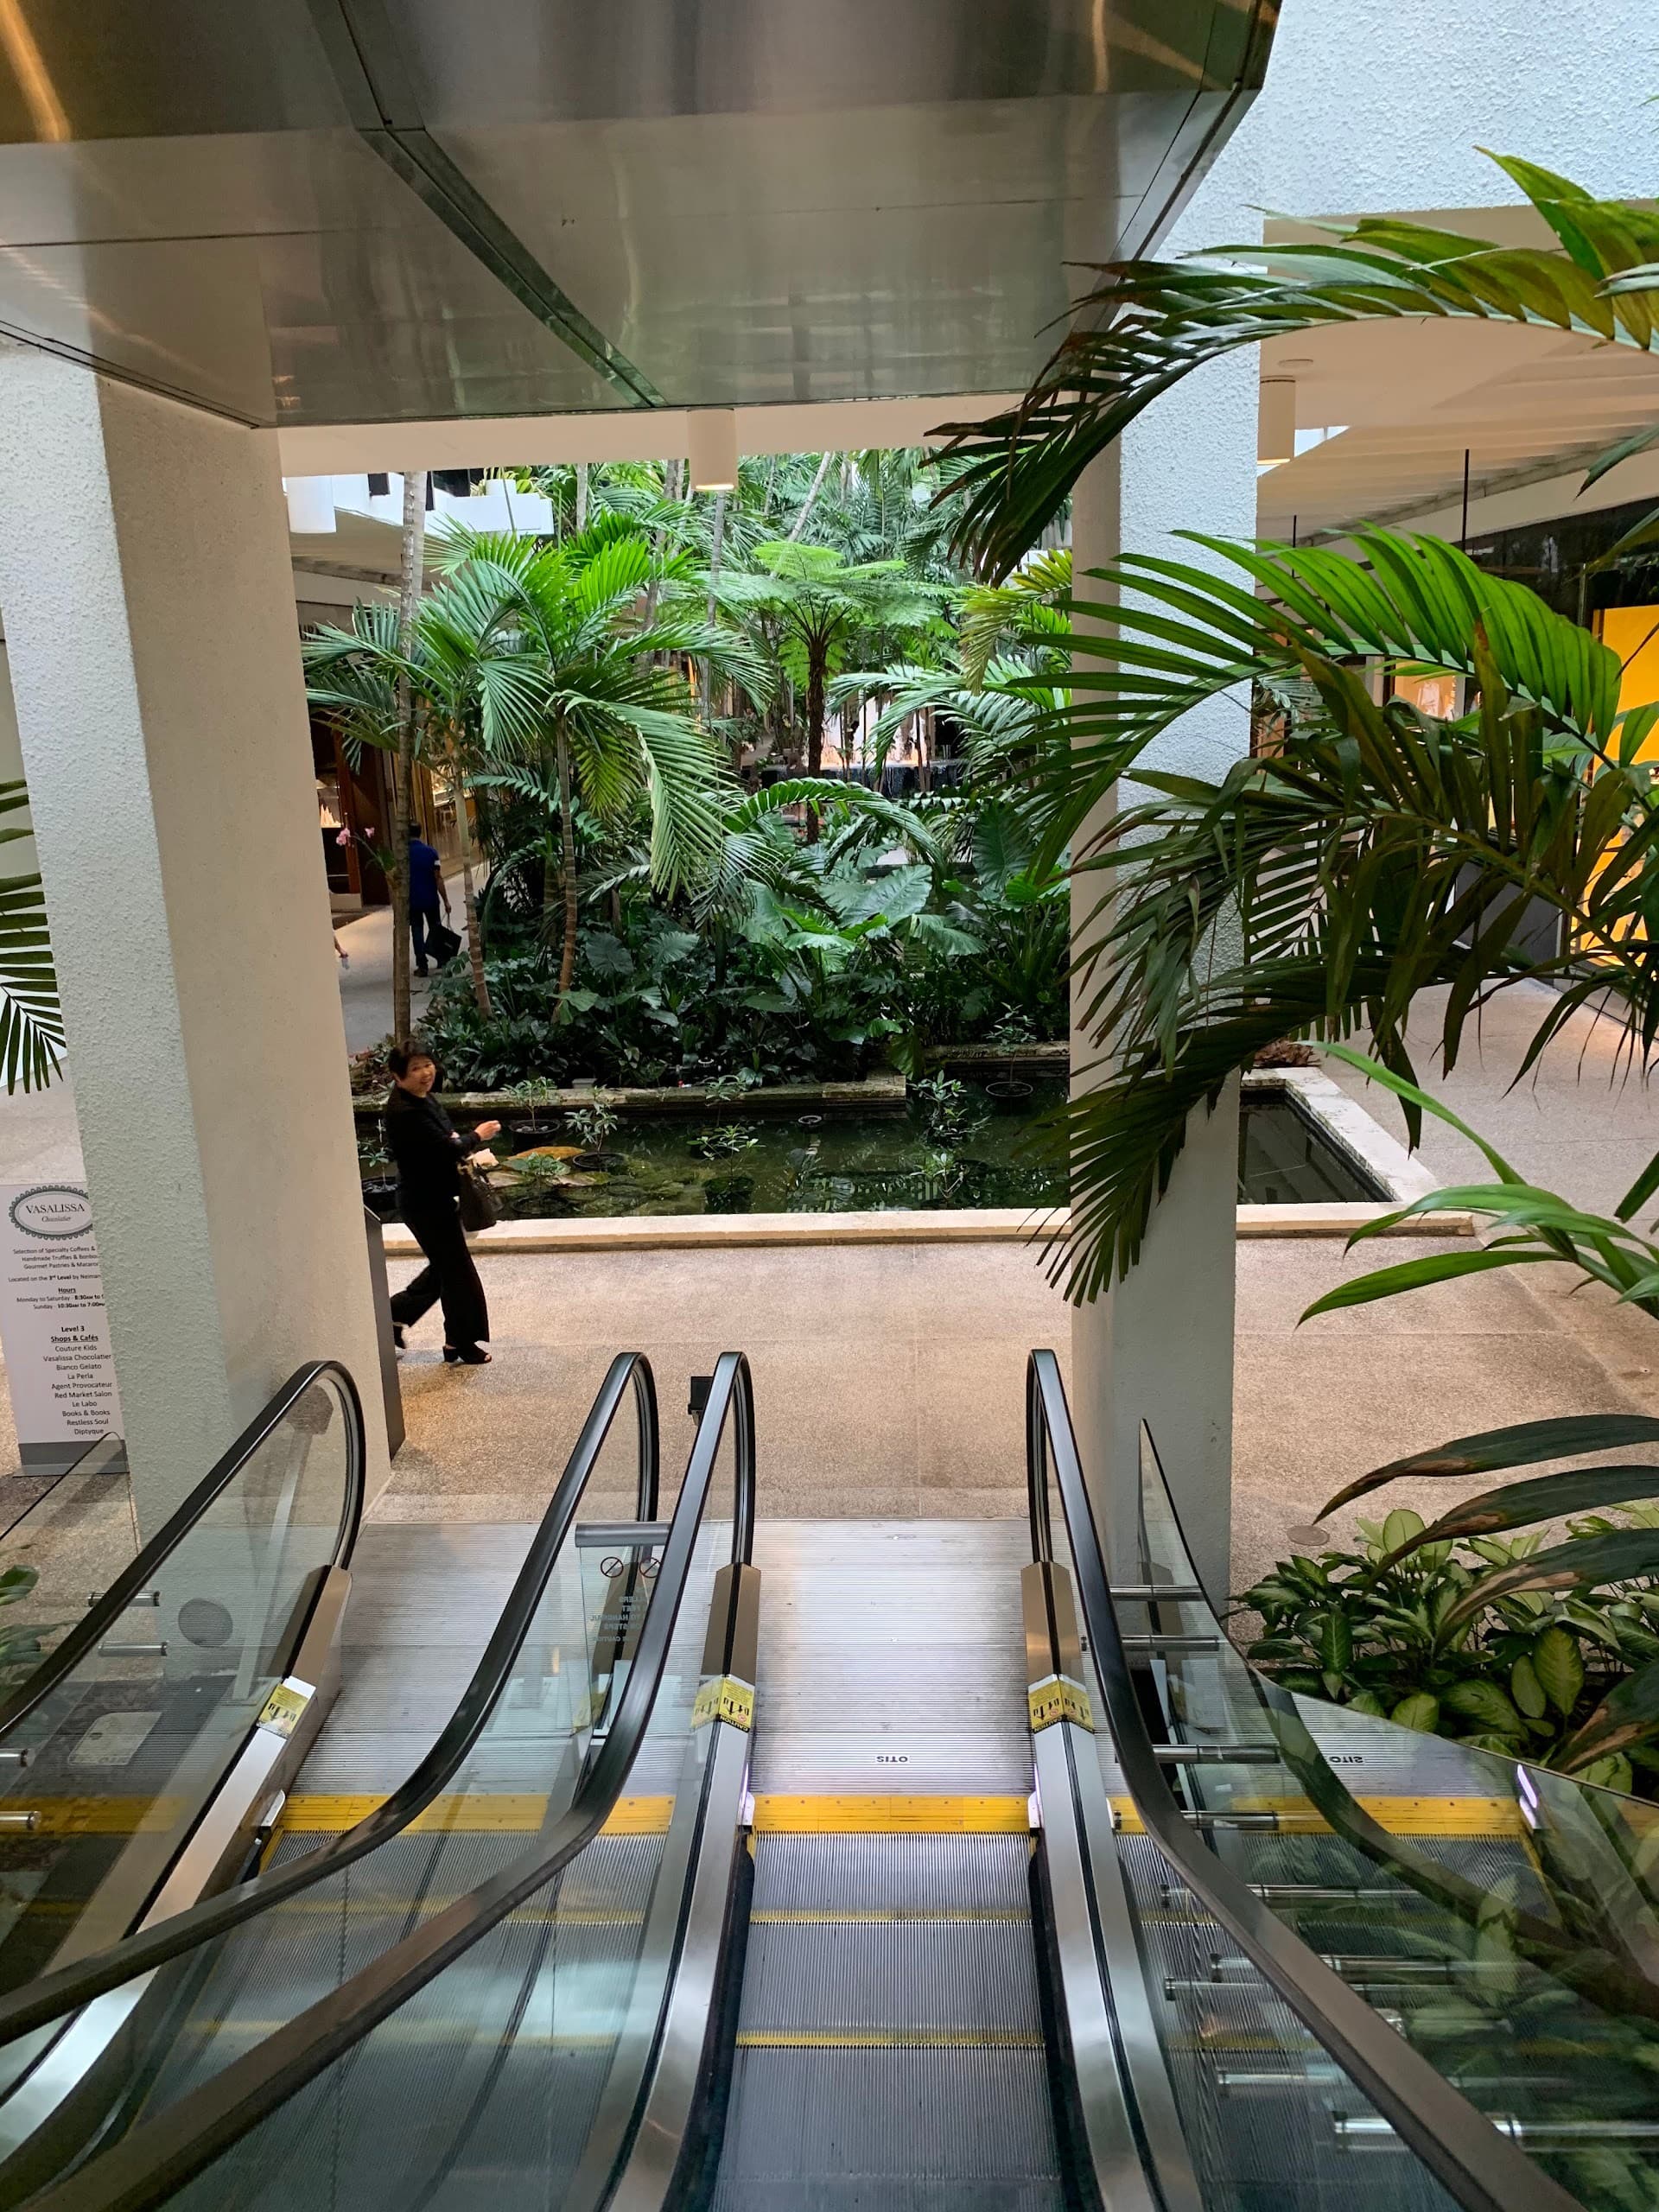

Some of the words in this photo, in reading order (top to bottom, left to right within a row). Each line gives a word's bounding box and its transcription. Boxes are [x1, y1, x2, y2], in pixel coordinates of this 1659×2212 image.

[26, 1203, 85, 1214] VASALISSA
[721, 1714, 749, 1732] CAUTION
[1033, 1714, 1063, 1732] CAUTION
[876, 1755, 909, 1764] OTIS
